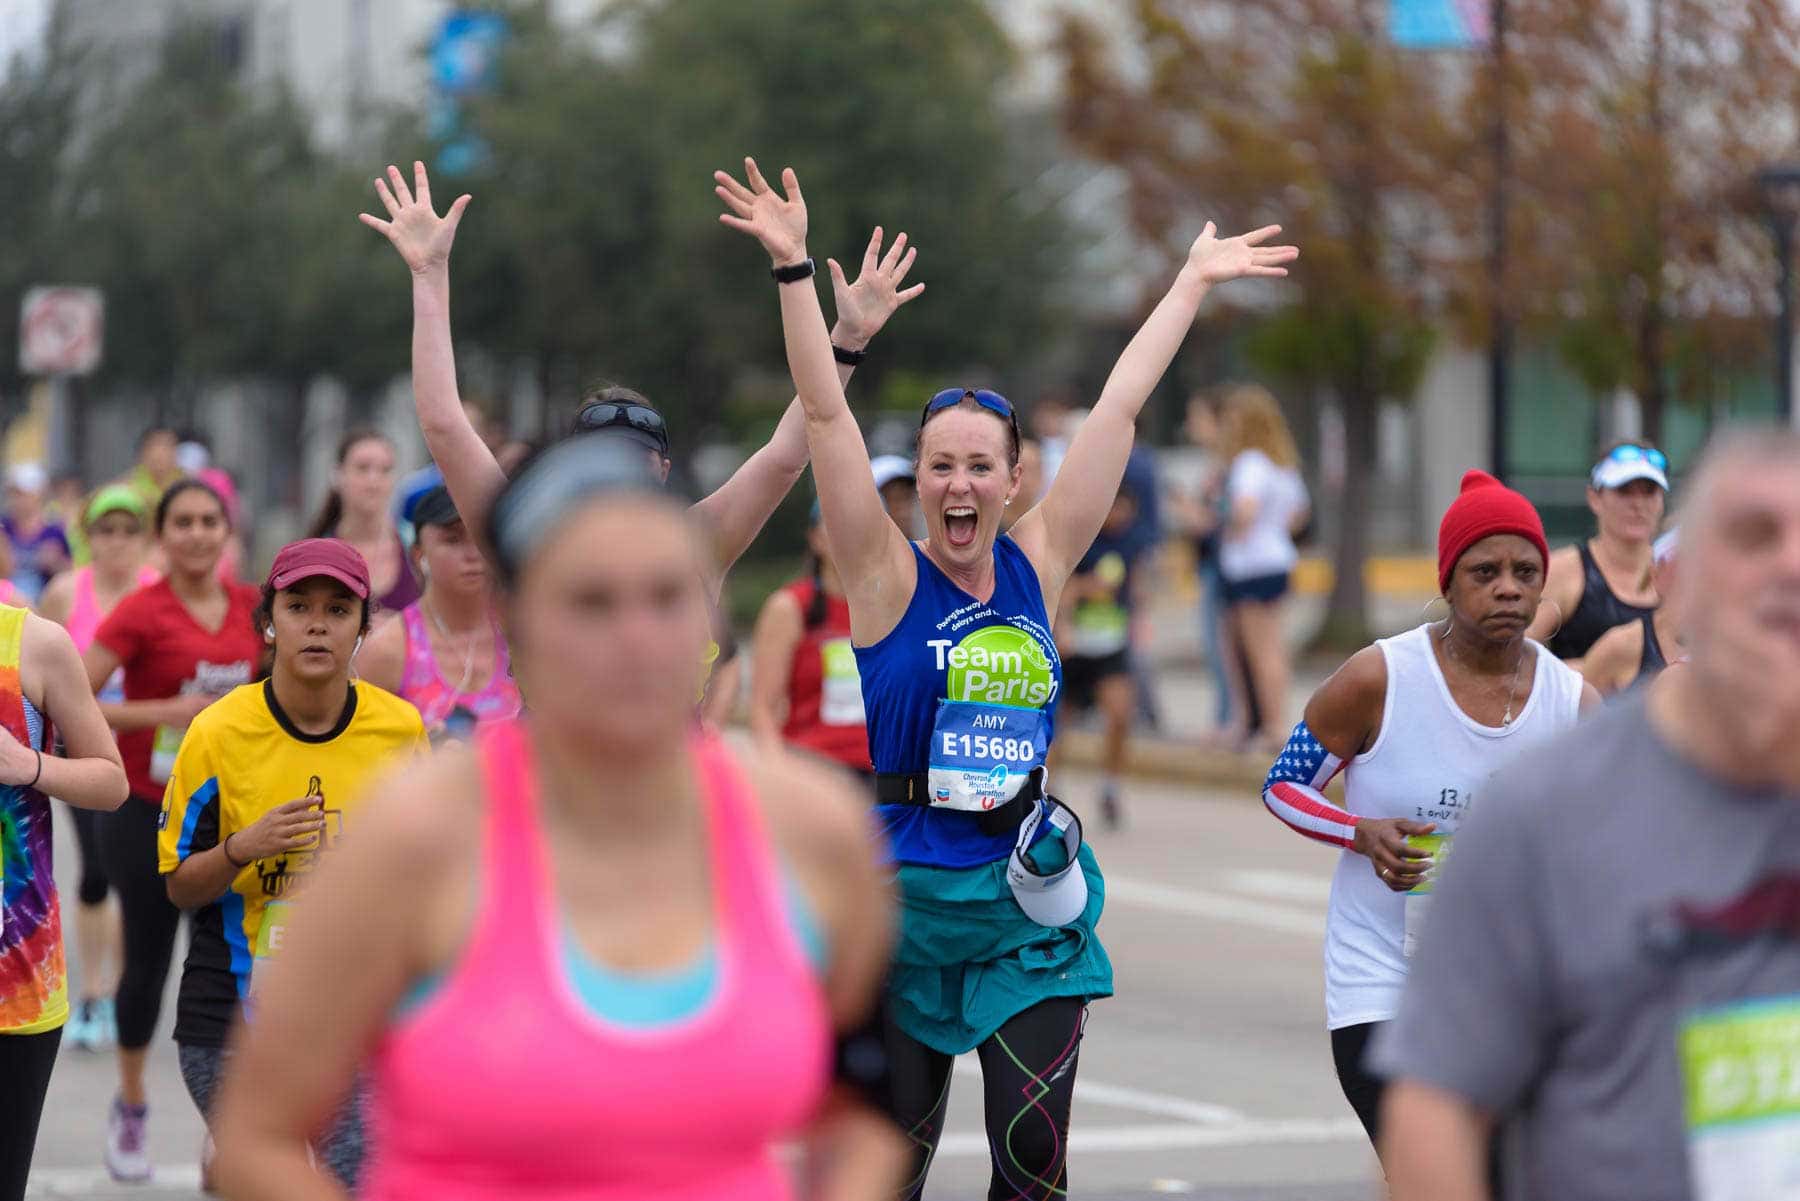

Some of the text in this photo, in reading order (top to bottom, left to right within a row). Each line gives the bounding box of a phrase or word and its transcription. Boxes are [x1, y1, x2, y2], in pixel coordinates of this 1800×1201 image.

[965, 601, 981, 612] way
[974, 608, 992, 619] and
[927, 639, 1022, 673] Team
[962, 668, 1059, 704] Parish
[972, 713, 1007, 730] AMY
[942, 731, 1034, 762] E15680
[963, 772, 987, 782] Chevron
[1427, 809, 1451, 820] only
